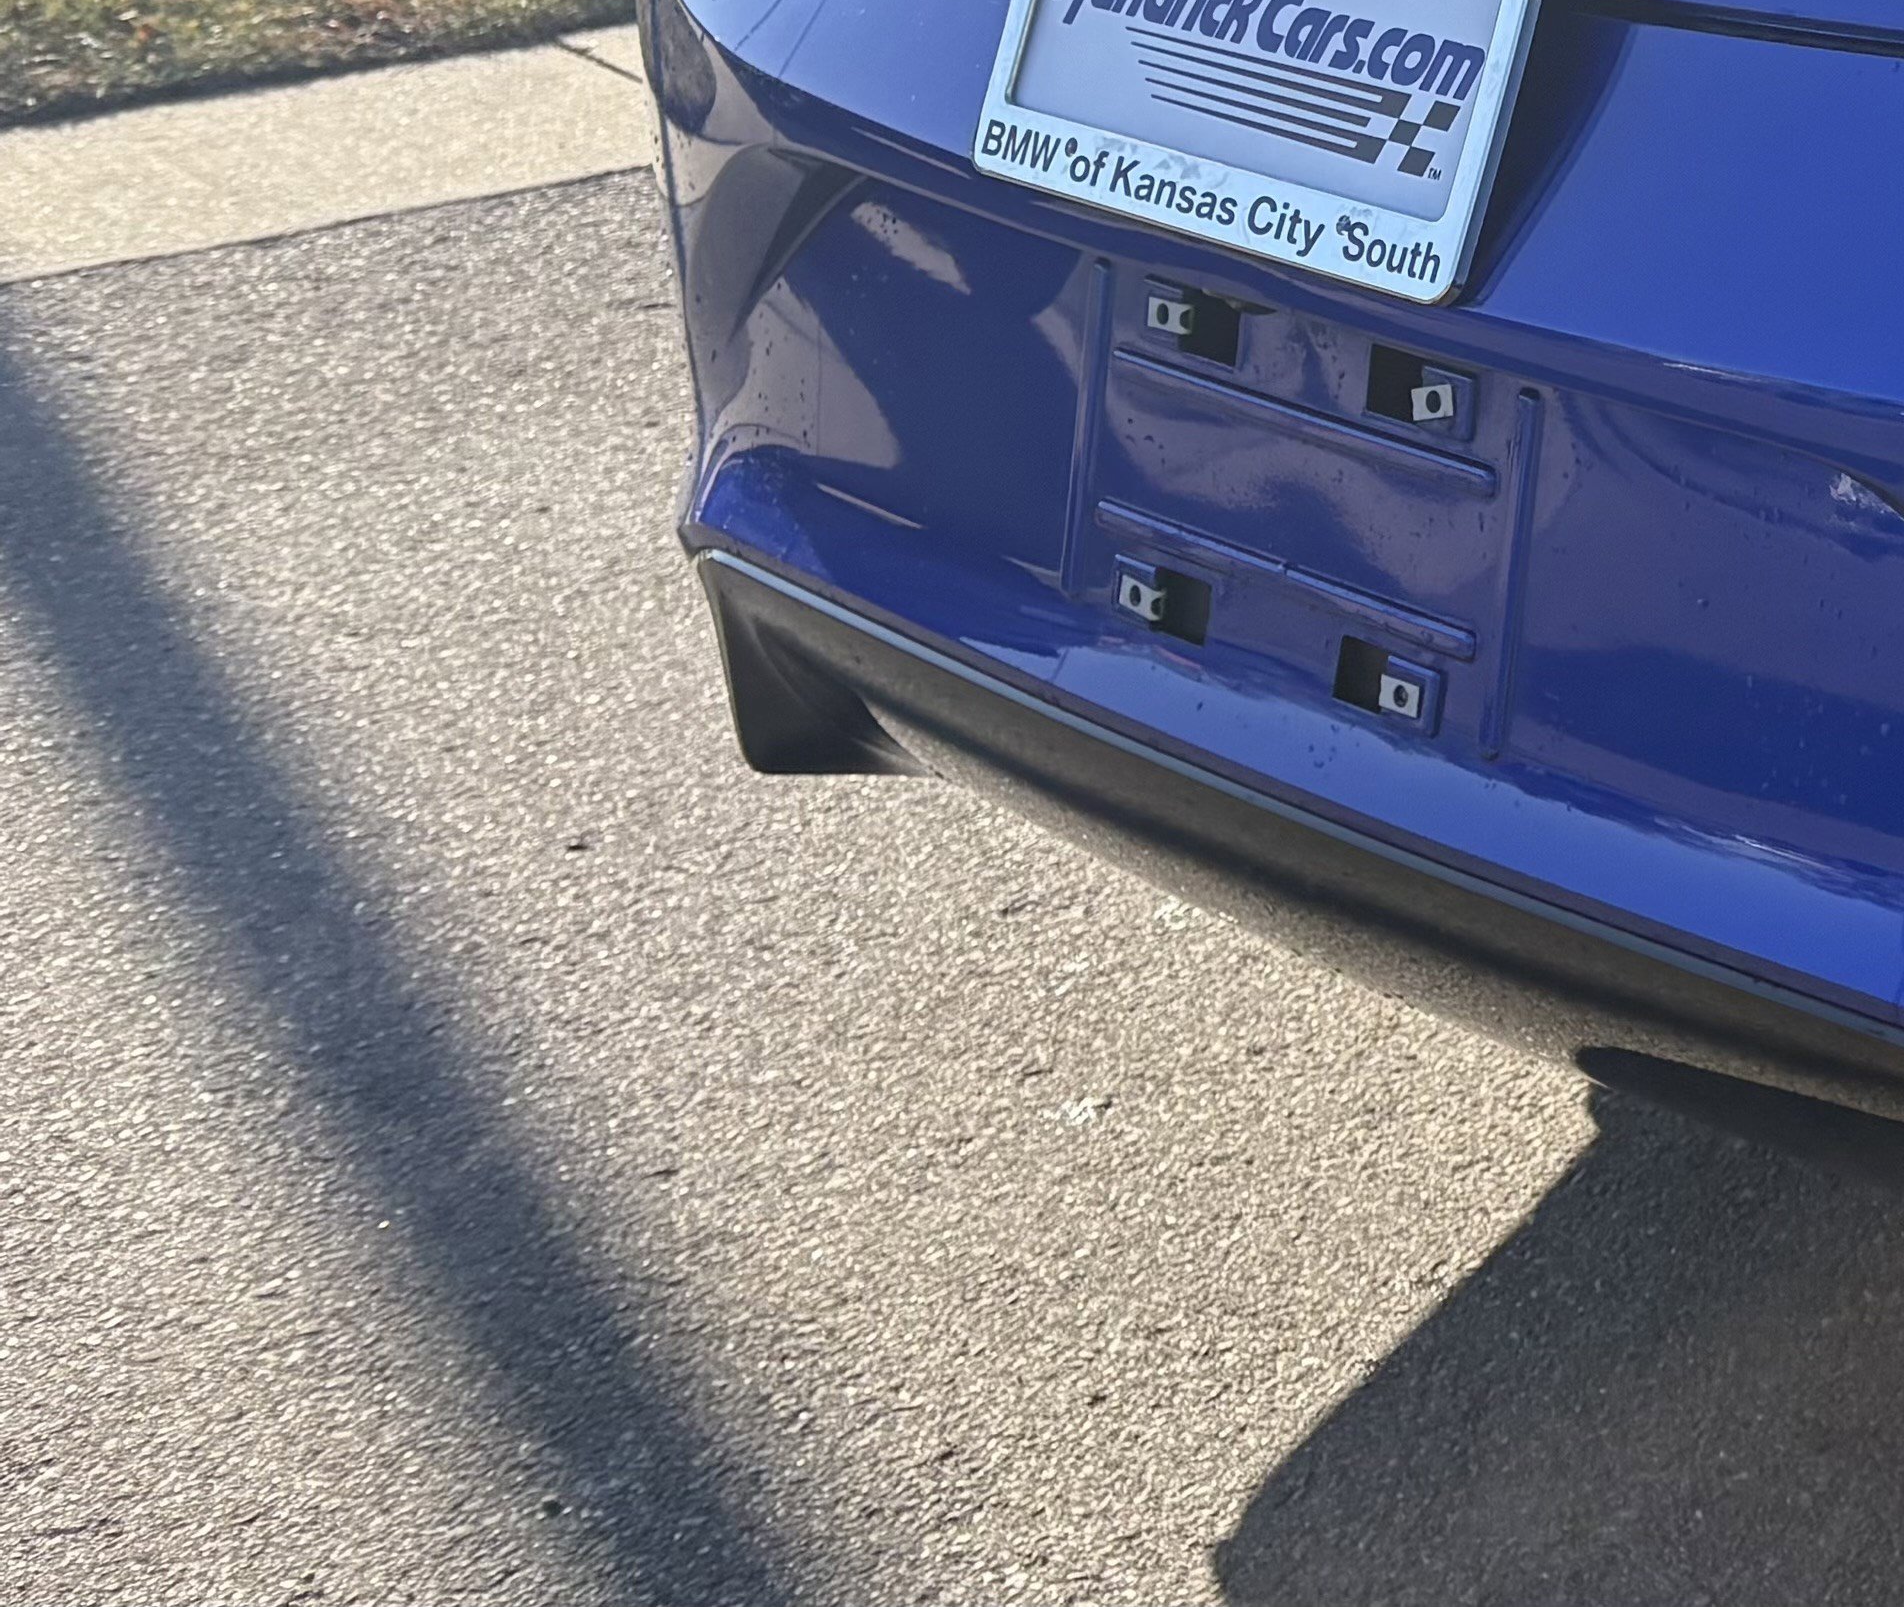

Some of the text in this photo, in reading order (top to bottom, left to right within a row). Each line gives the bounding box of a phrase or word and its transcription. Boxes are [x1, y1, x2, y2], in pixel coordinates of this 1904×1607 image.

[979, 119, 1441, 282] BMW of Kansas City South
